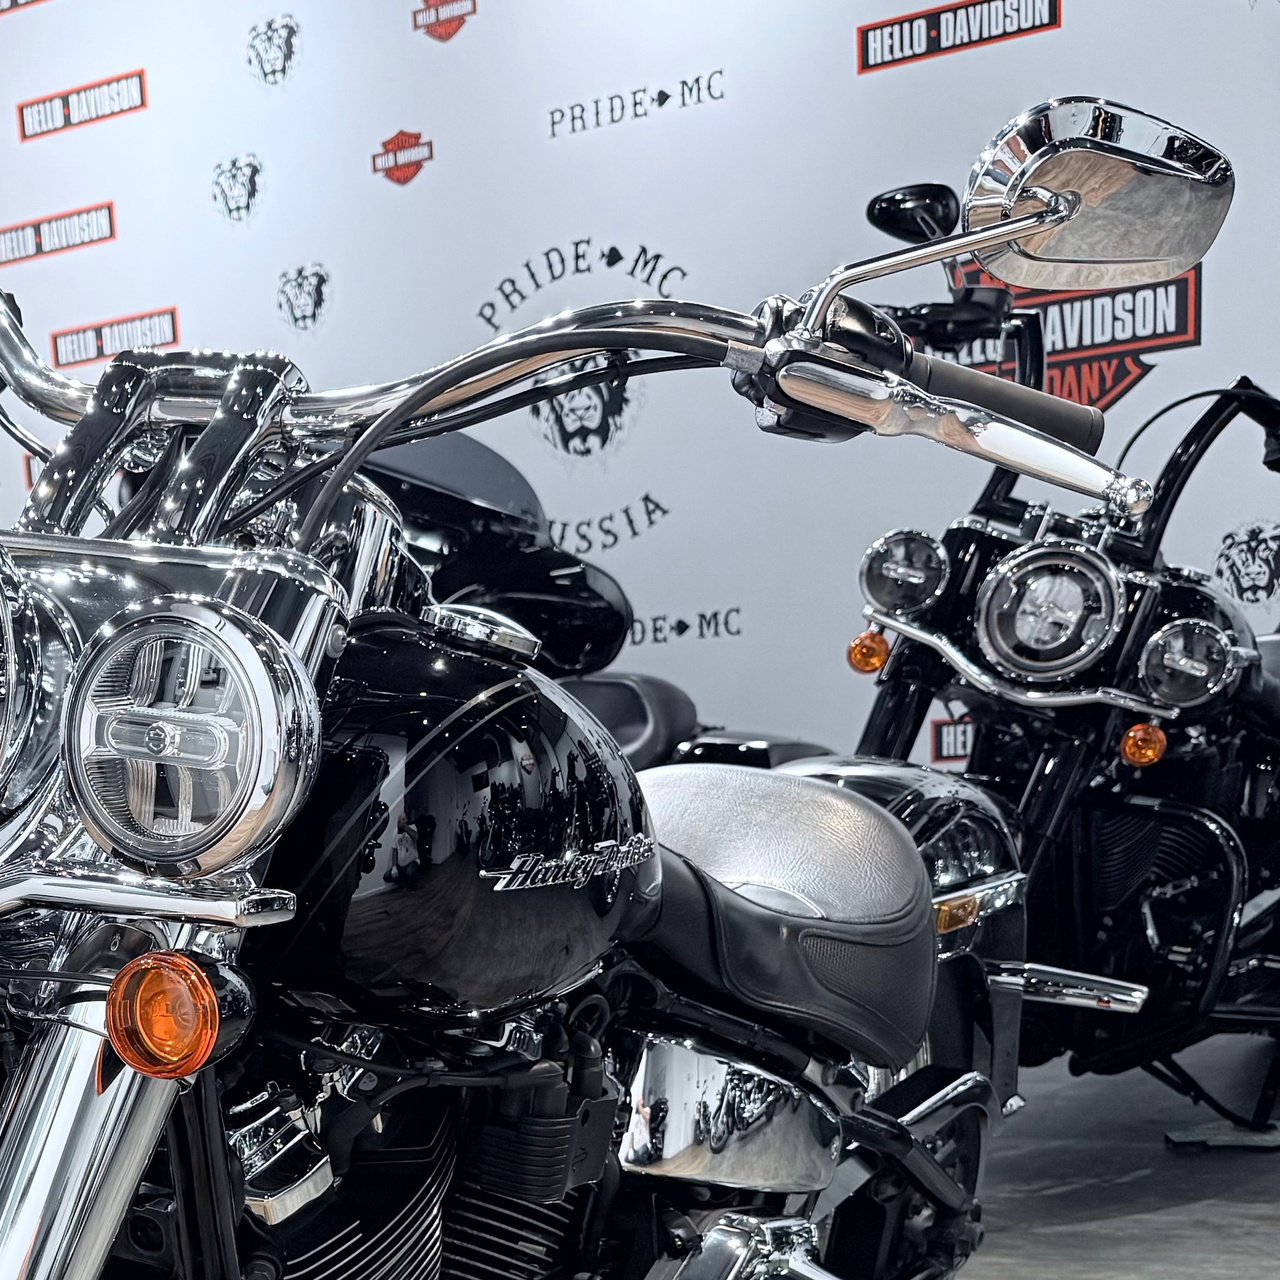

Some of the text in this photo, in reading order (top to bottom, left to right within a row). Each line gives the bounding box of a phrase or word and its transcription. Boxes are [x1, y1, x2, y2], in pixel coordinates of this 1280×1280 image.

[867, 0, 1050, 66] HELLO DAVIDSON
[22, 75, 142, 138] HELLO DAVIDSON
[548, 68, 725, 139] PRIDE MC
[40, 205, 112, 253] DAVIDSON
[475, 236, 688, 333] PRIDE MC
[1045, 284, 1177, 351] AVIDSON
[548, 490, 671, 555] USSIA
[696, 605, 741, 640] MC
